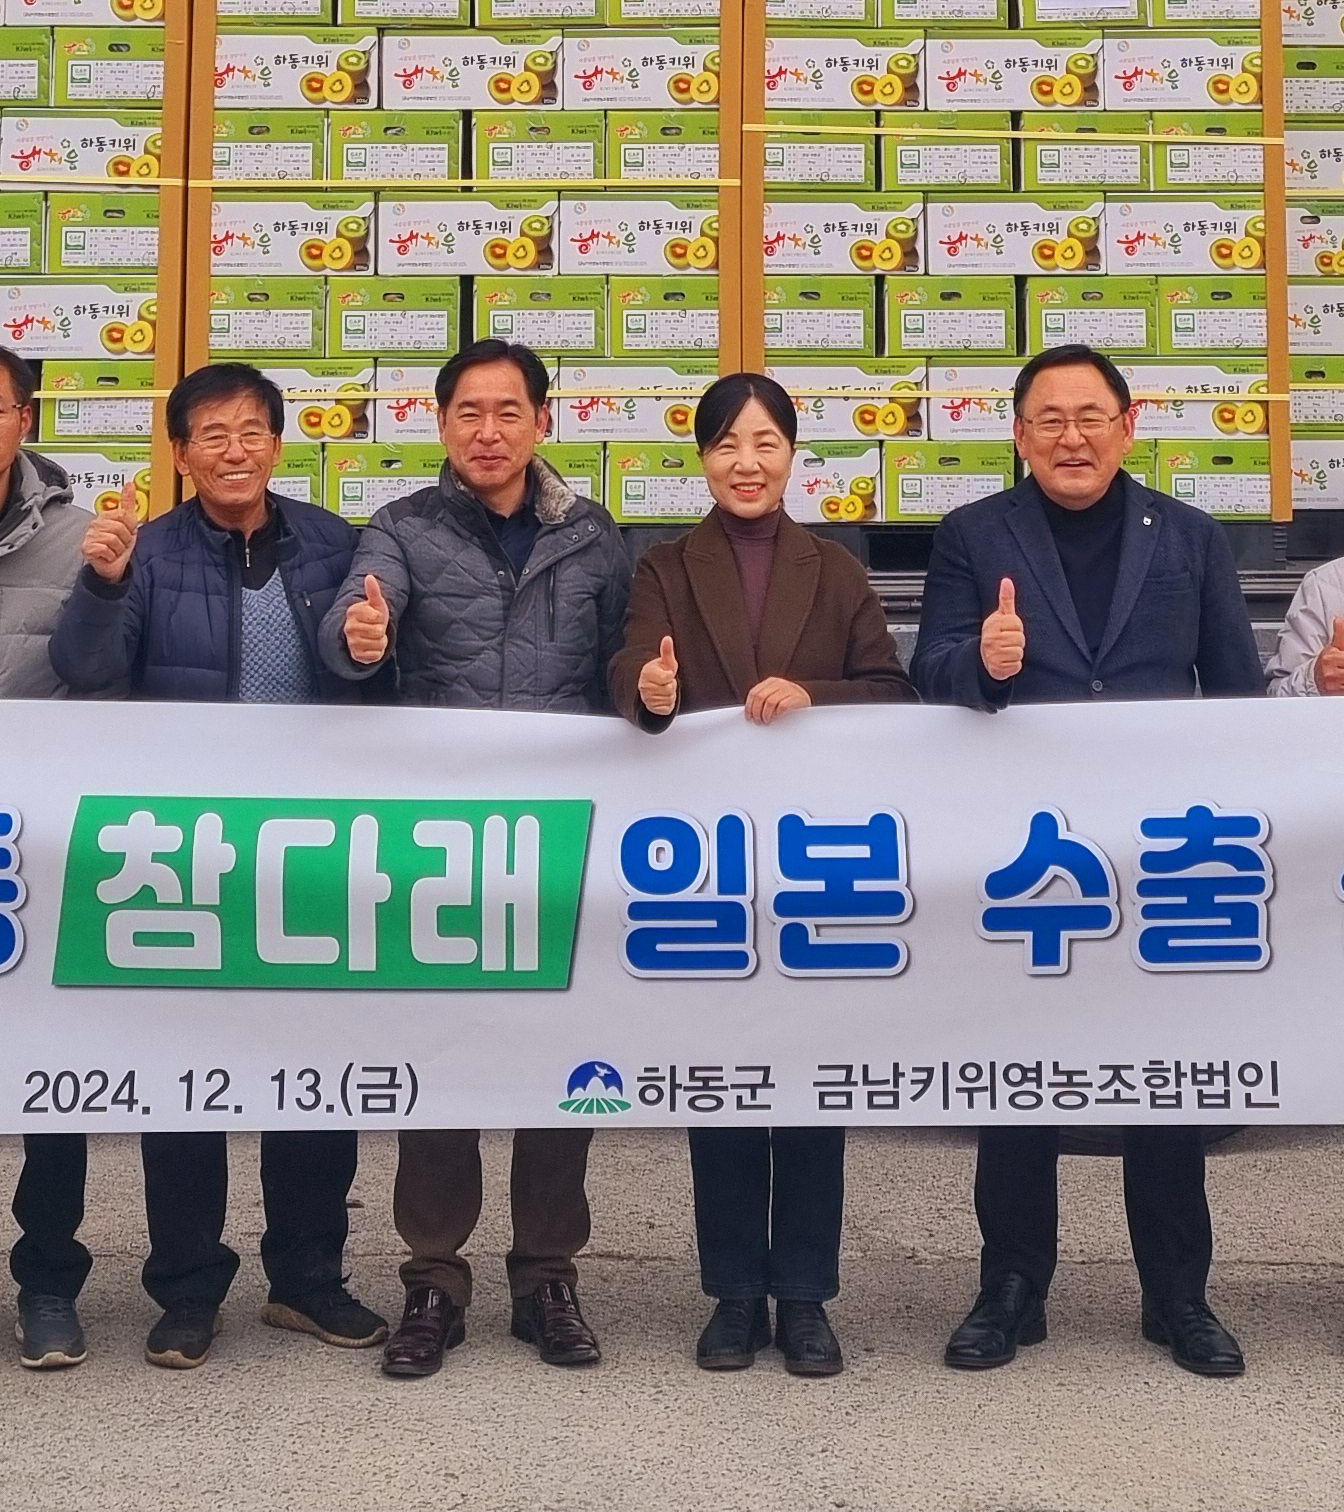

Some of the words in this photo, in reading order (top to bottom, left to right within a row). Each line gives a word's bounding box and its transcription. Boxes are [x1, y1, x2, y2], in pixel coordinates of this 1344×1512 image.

[274, 53, 329, 70] 하동키위
[462, 54, 516, 71] 하동키위
[641, 54, 695, 71] 하동키위
[825, 56, 879, 73] 하동키위
[1004, 56, 1058, 73] 하동키위
[1180, 56, 1234, 72] 하동키위
[80, 136, 136, 153] 하동키위
[273, 220, 328, 237] 하동키위
[457, 219, 512, 236] 하동키위
[638, 219, 692, 236] 하동키위
[823, 221, 878, 238] 하동키위
[1006, 220, 1059, 237] 하동키위
[1183, 220, 1237, 237] 하동키위
[73, 303, 130, 320] 하동키위
[67, 472, 125, 489] 하동키위
[95, 809, 542, 972] 참다래
[619, 810, 908, 972] 일본
[980, 804, 1268, 969] 수출
[22, 1069, 152, 1115] 2024.
[178, 1068, 244, 1114] 12.
[269, 1062, 420, 1117] 13.(금)
[636, 1063, 776, 1113] 하동군
[812, 1060, 1281, 1111] 금남키위영농조합법인
